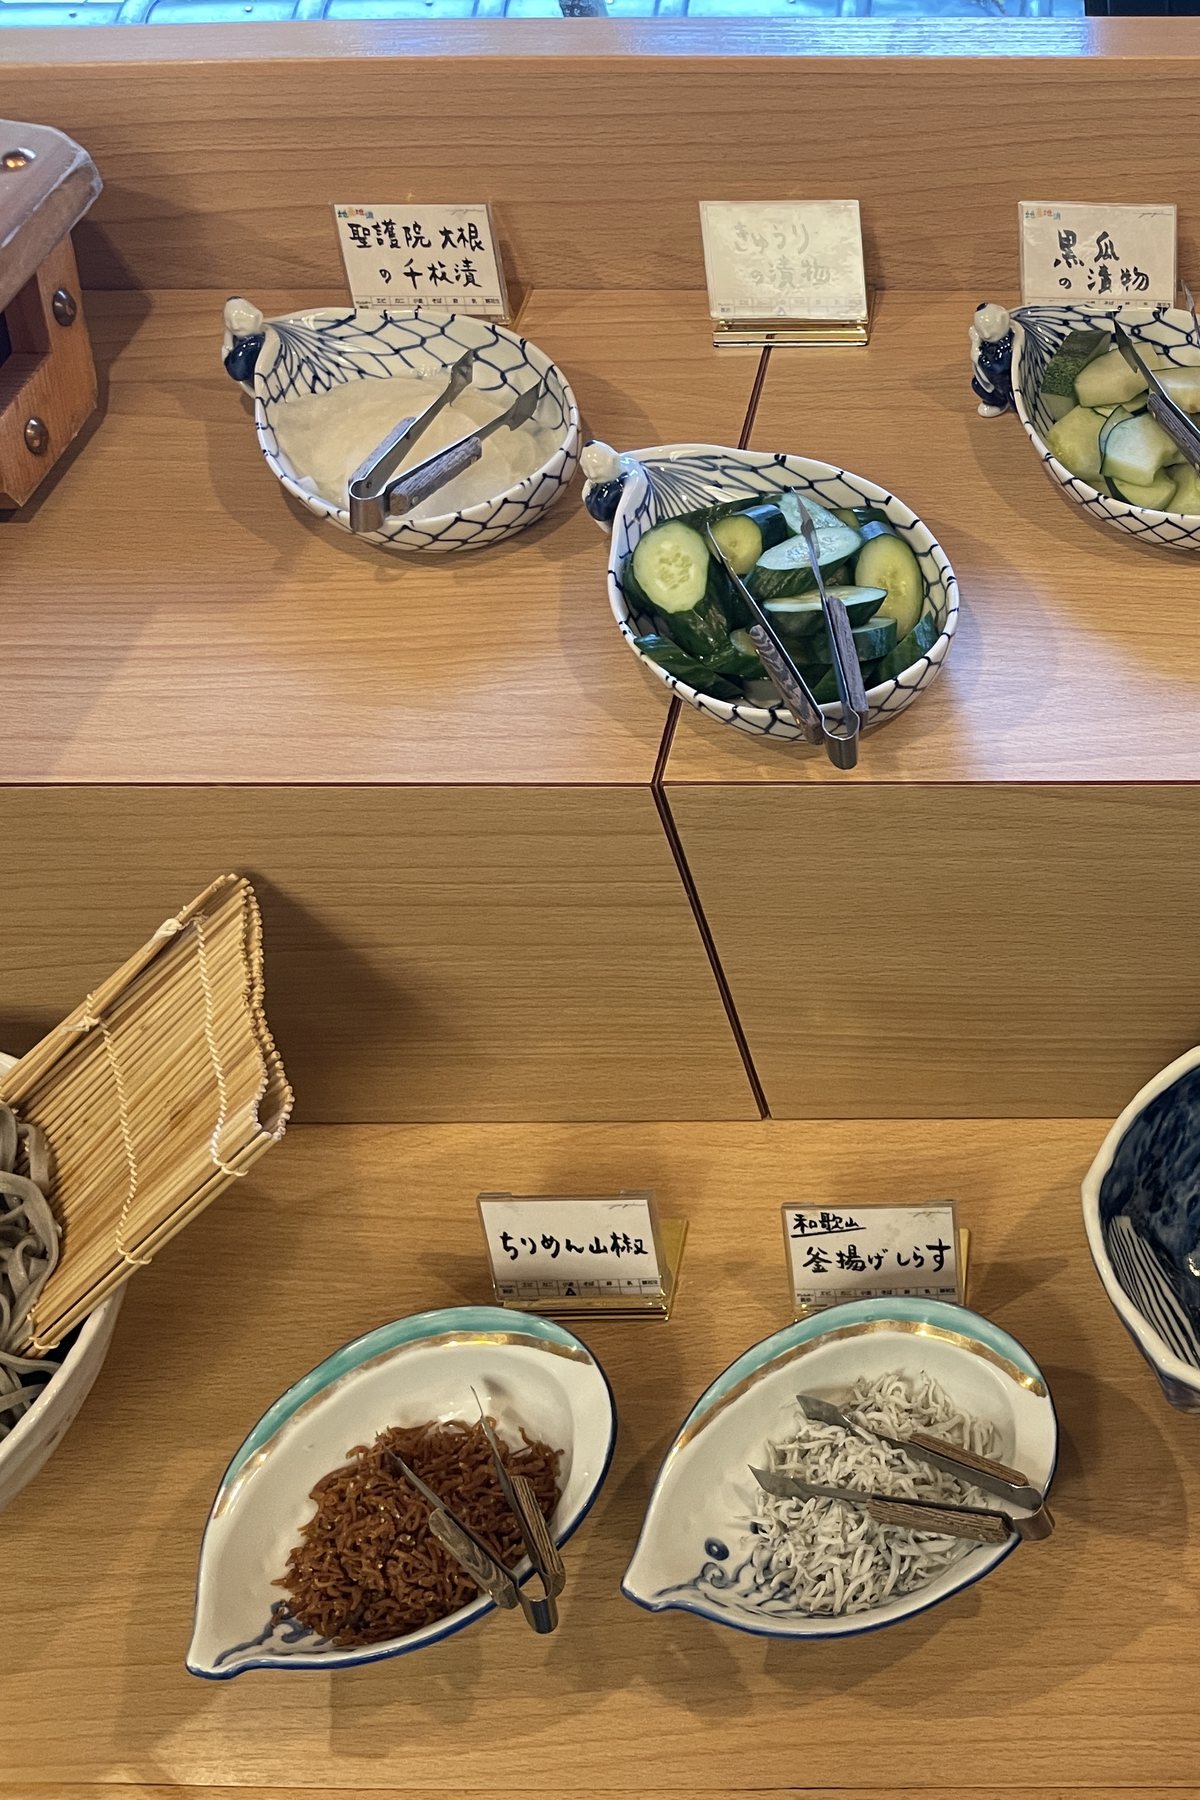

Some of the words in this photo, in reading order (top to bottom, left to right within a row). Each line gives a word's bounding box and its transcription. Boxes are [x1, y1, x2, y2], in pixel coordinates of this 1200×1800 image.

[734, 221, 810, 255] きゅうり
[1053, 229, 1120, 268] 黒瓜
[1058, 263, 1150, 295] の漬物
[793, 1212, 860, 1234] 和歌山
[499, 1231, 648, 1260] ちりめん山椒
